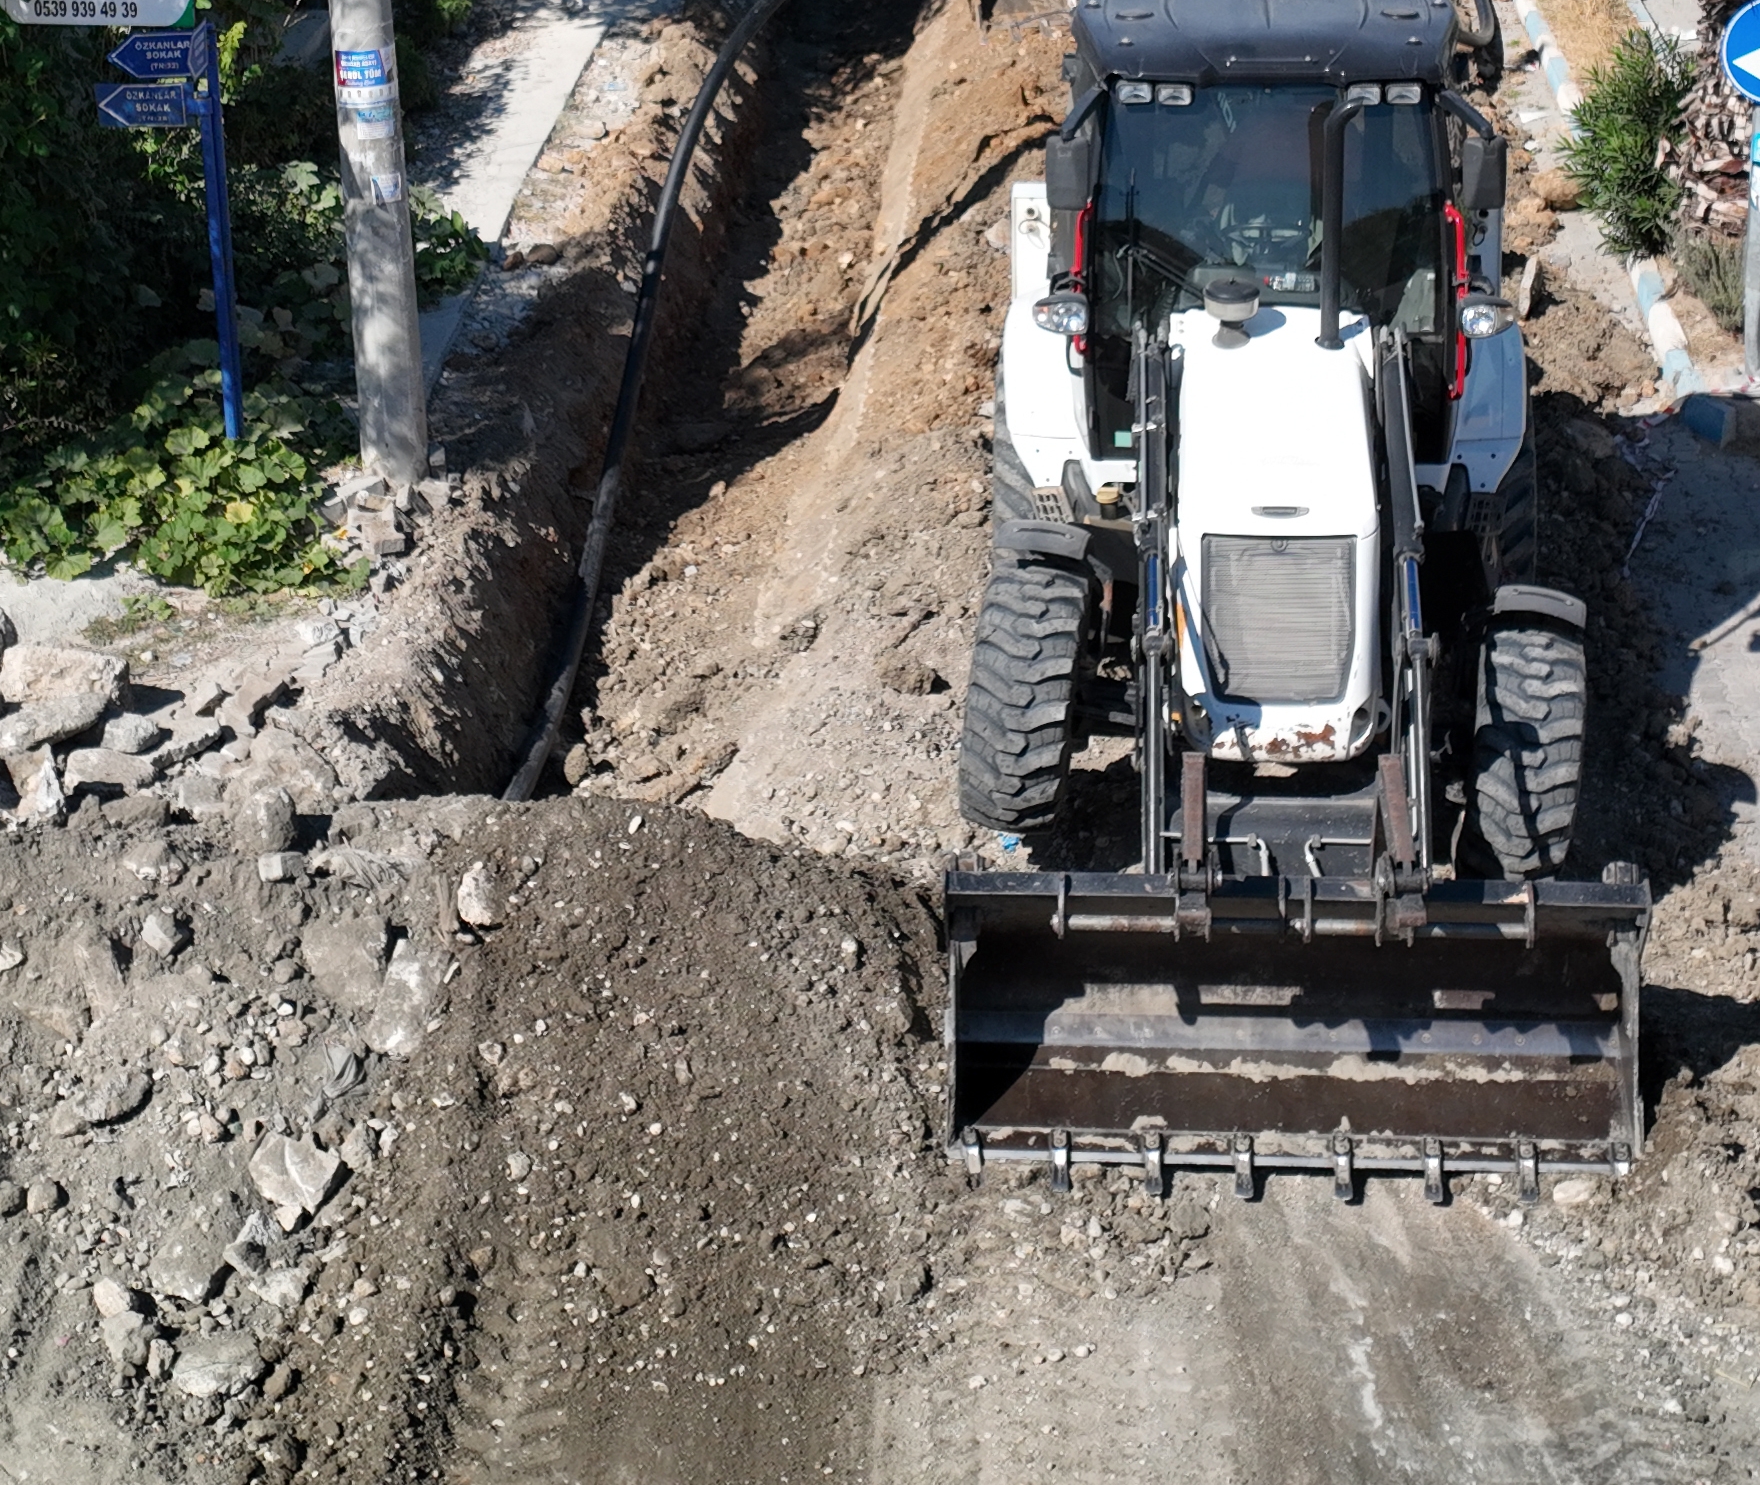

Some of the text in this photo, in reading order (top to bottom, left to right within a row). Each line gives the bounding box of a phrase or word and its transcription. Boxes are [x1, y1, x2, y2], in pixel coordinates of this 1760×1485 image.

[34, 0, 138, 19] 0539 939 49 39
[134, 40, 191, 51] ÖZKANLAR
[145, 50, 182, 60] SOKAK
[135, 102, 171, 113] SOKAK
